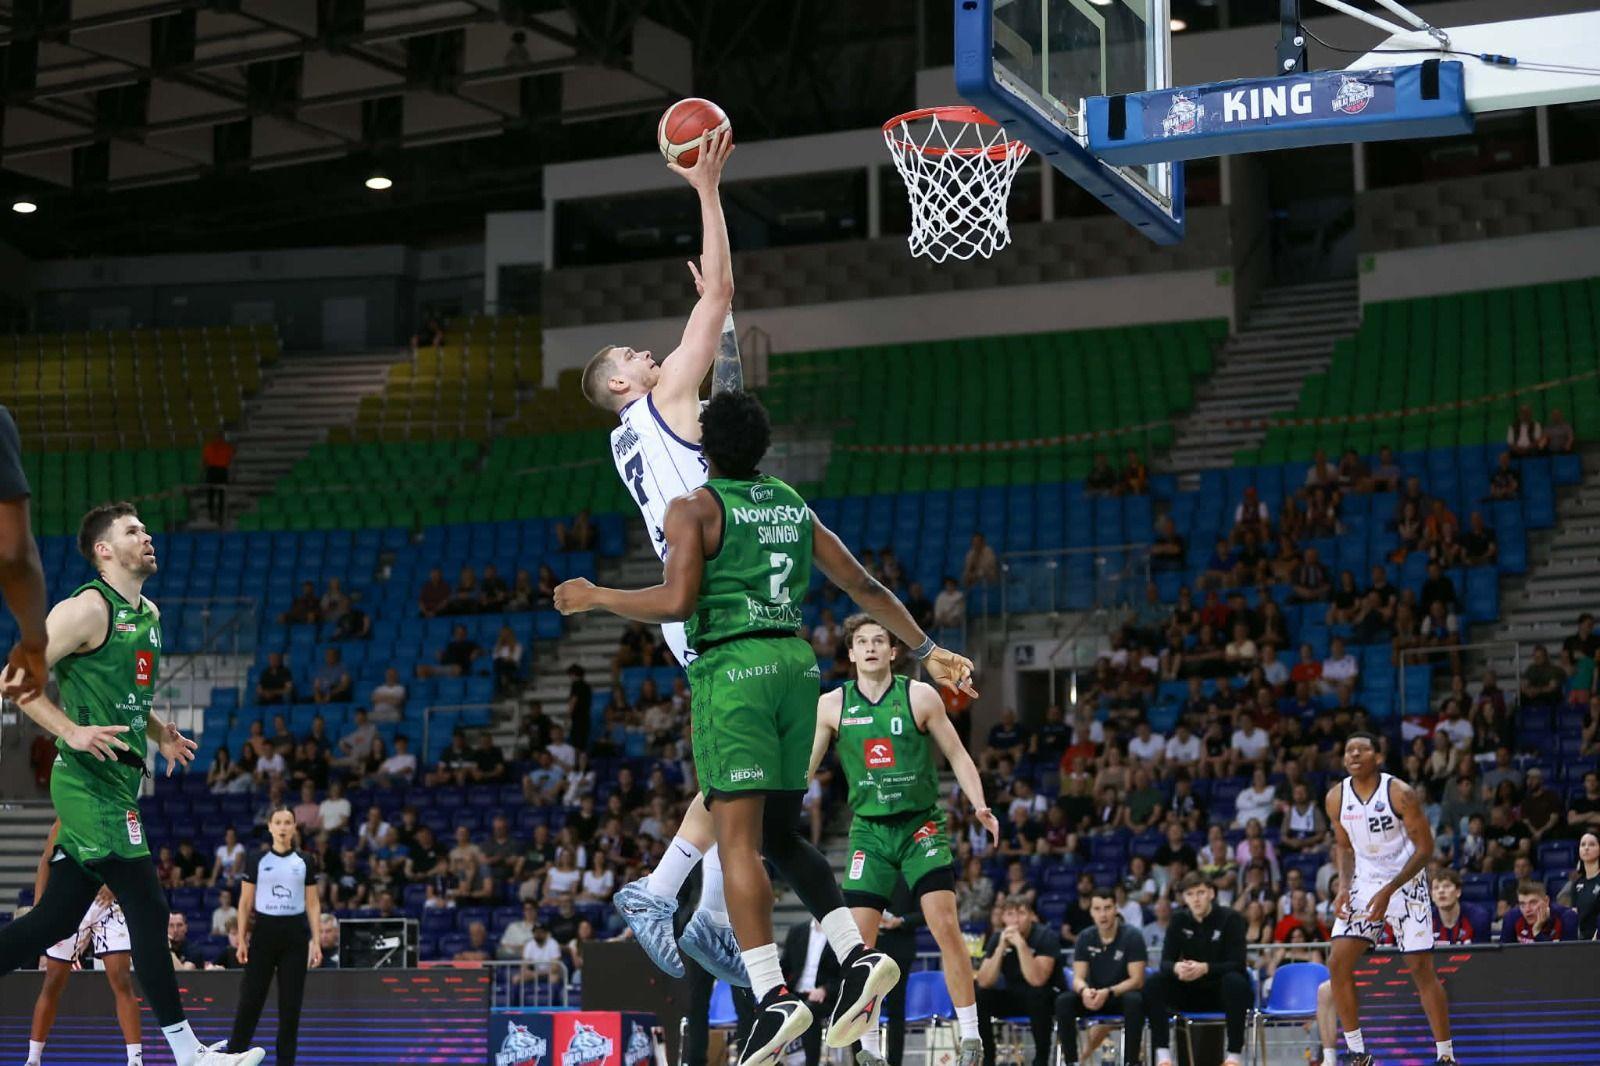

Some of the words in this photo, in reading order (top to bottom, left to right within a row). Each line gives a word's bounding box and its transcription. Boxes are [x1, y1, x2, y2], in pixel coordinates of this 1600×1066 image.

[1223, 83, 1312, 122] KING
[624, 451, 649, 506] 7
[769, 552, 794, 604] 2
[149, 626, 161, 648] 4
[727, 663, 778, 682] VANDER
[890, 716, 903, 735] 0
[1368, 815, 1395, 833] 22
